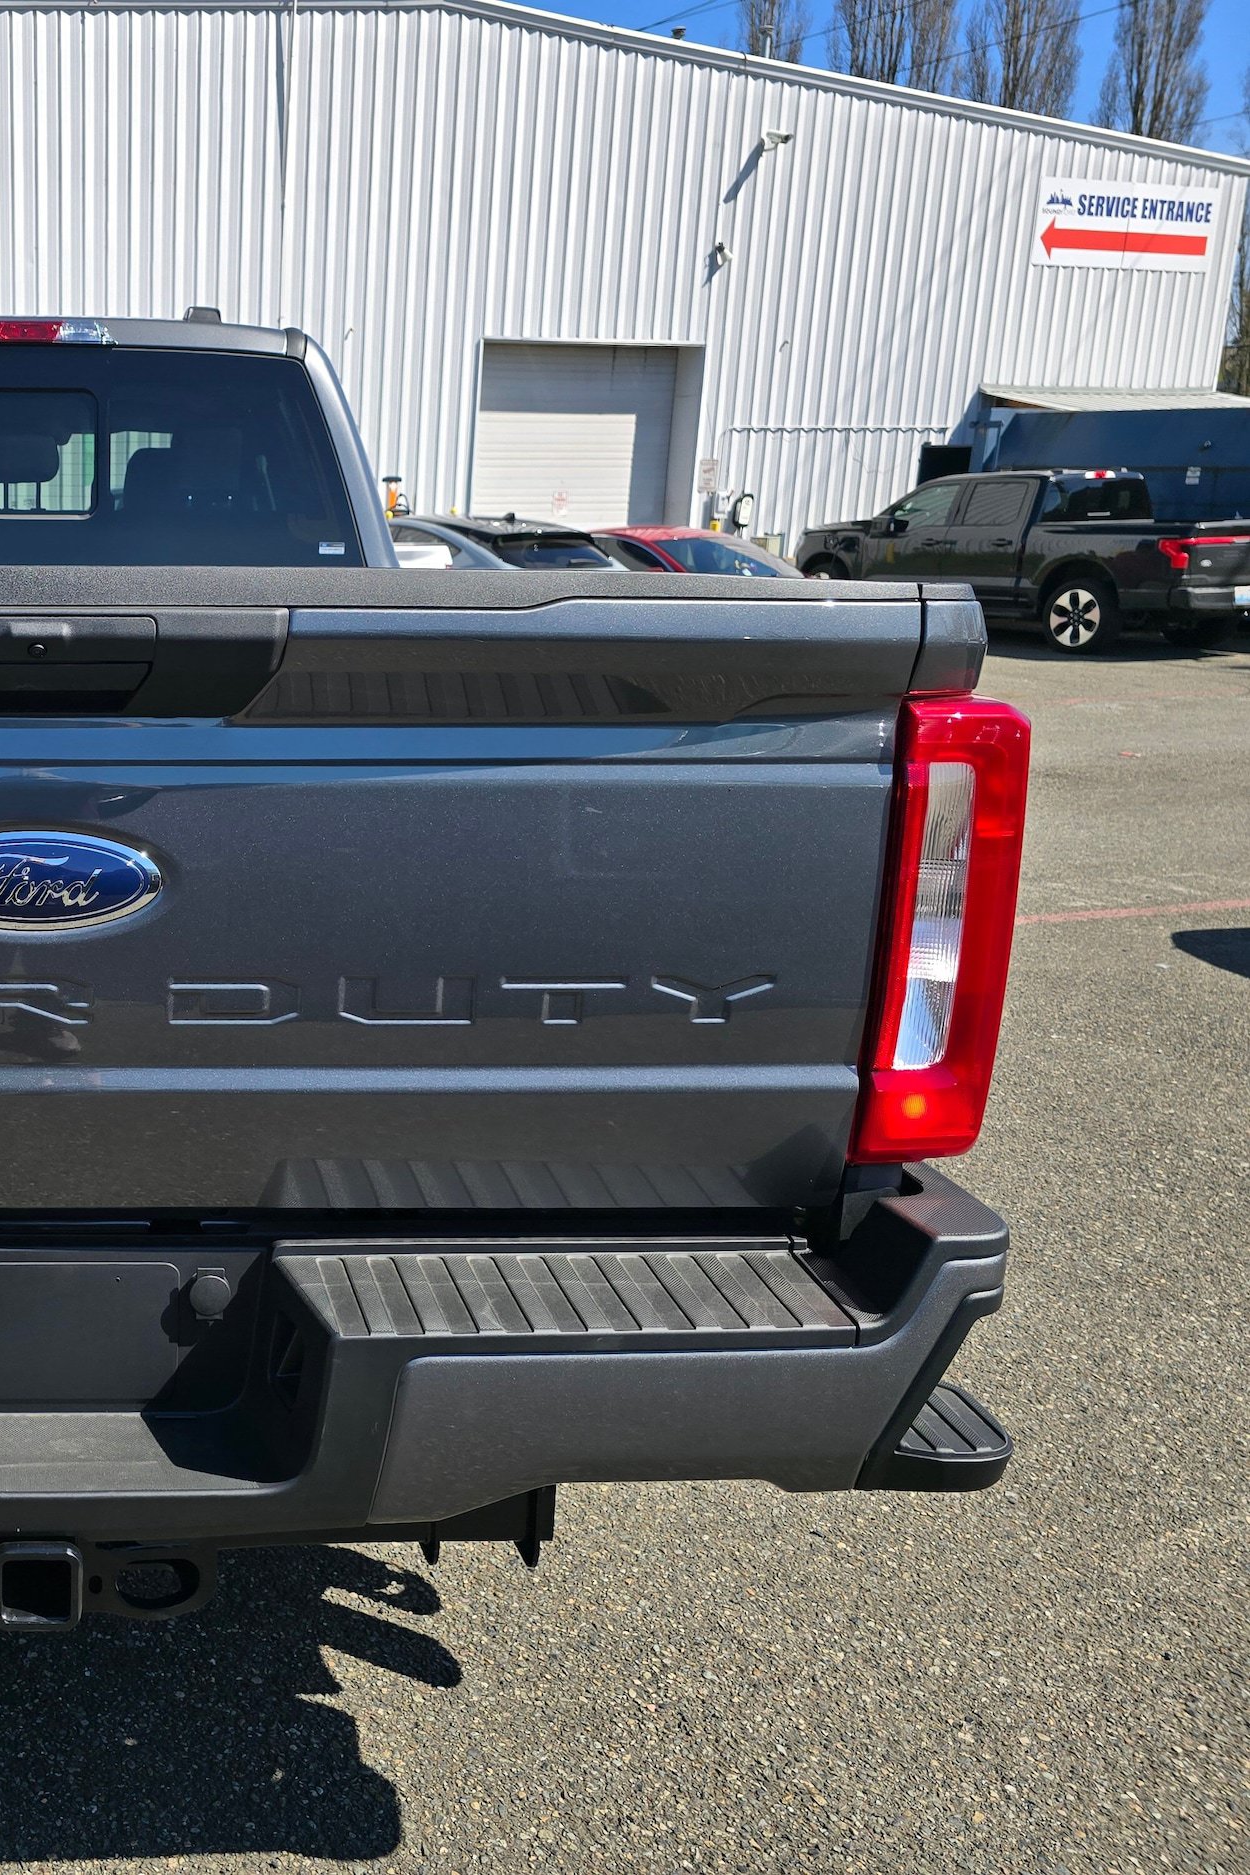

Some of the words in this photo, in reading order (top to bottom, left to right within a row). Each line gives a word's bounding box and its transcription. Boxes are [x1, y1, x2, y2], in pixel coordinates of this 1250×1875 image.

[1077, 194, 1138, 219] SERVICE
[1141, 198, 1213, 223] ENTRANCE
[166, 972, 779, 1026] DUTY
